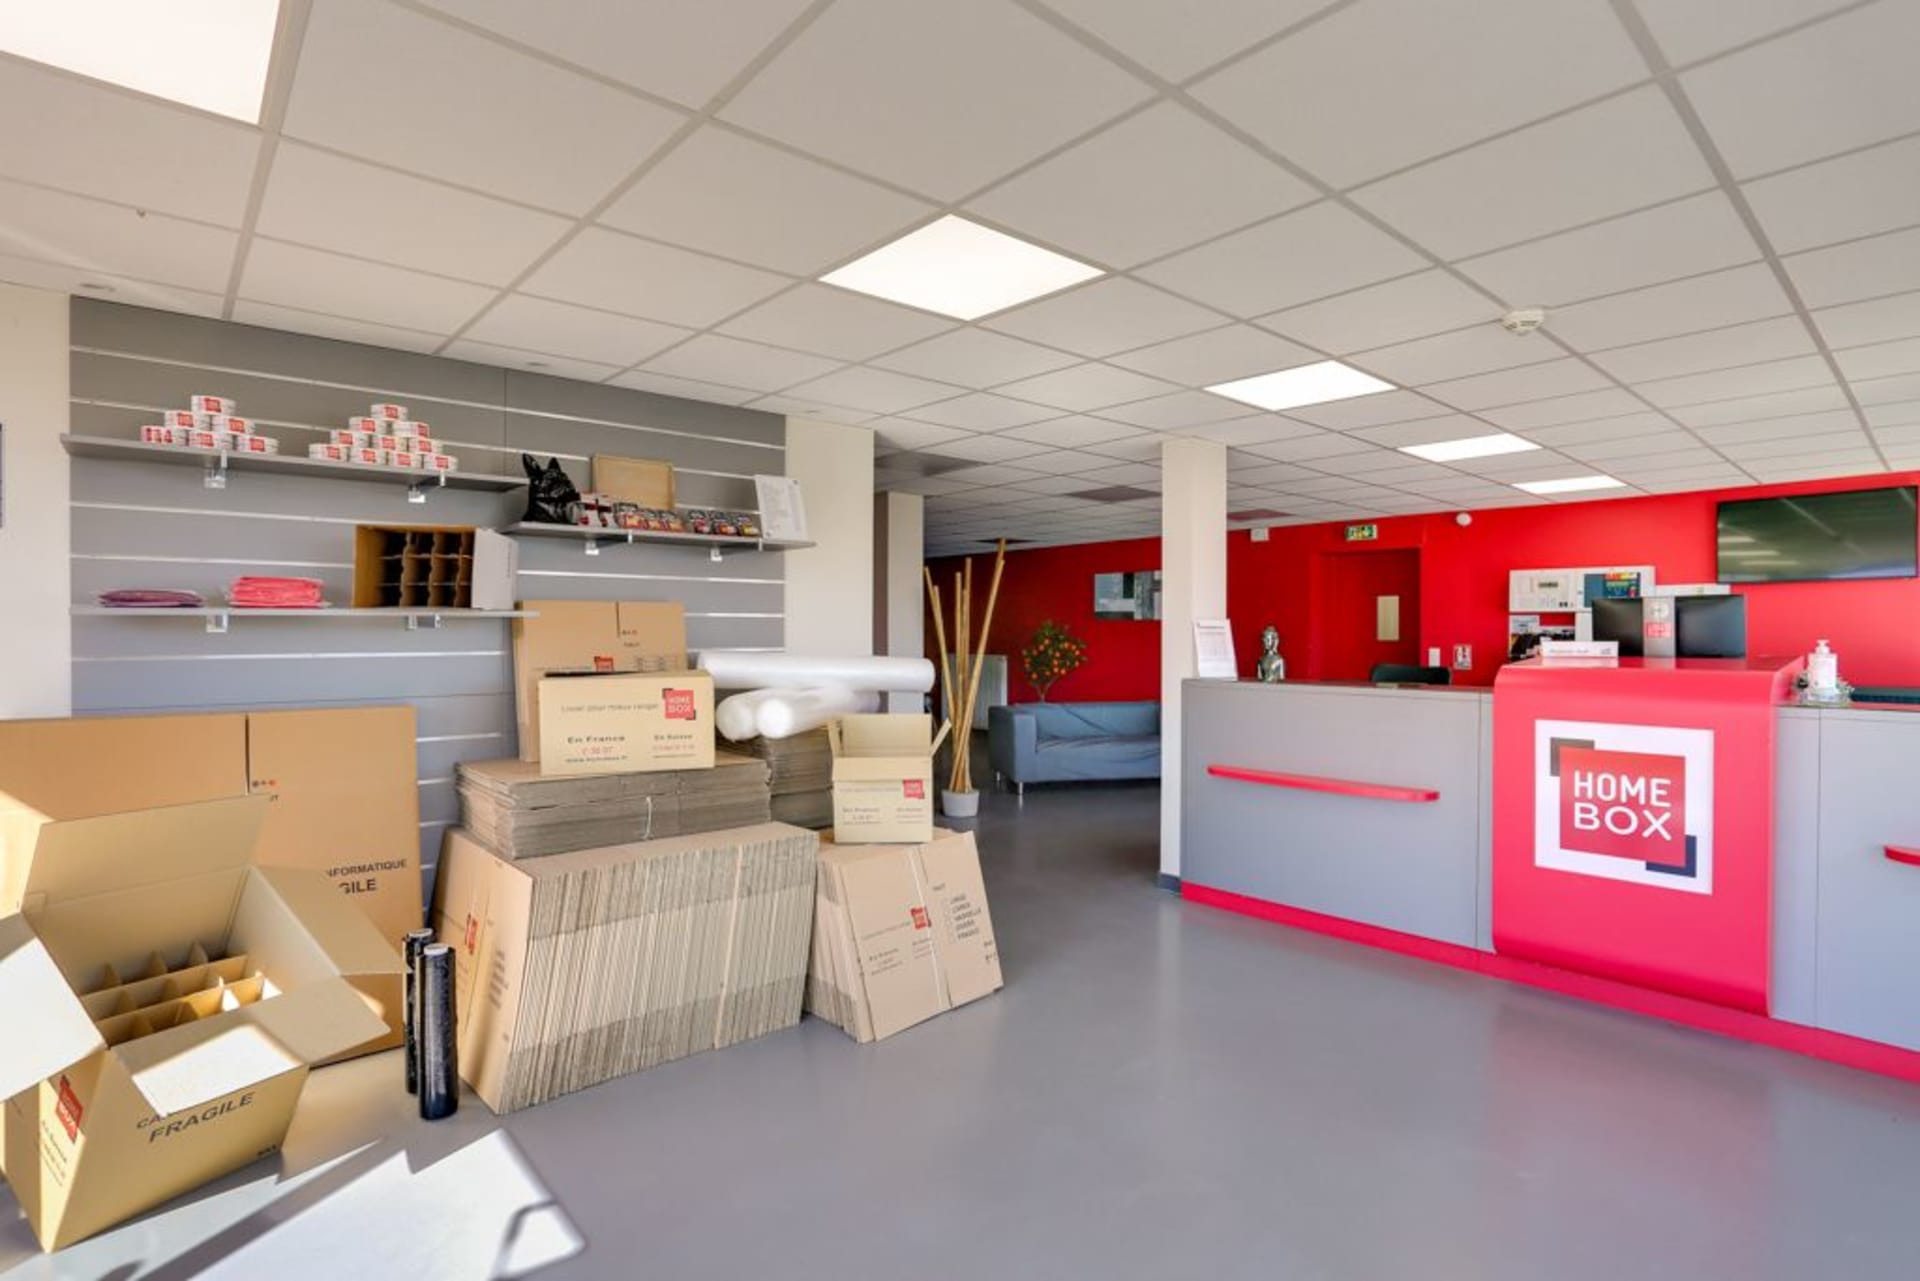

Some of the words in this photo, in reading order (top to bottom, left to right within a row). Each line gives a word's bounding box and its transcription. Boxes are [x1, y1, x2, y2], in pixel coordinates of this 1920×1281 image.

[668, 704, 692, 713] BOX
[586, 735, 625, 743] France
[1574, 770, 1672, 807] HOME
[1574, 802, 1672, 841] BOX
[149, 1091, 256, 1143] FRAGILE
